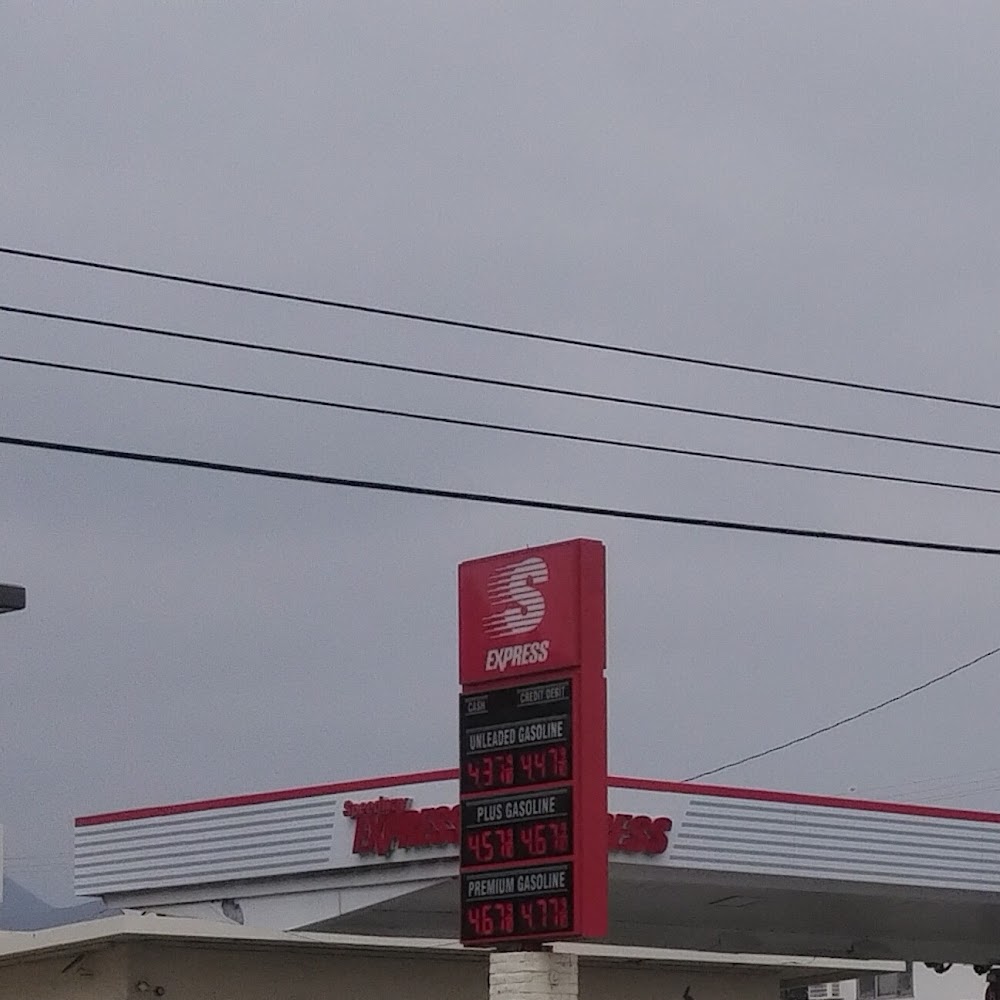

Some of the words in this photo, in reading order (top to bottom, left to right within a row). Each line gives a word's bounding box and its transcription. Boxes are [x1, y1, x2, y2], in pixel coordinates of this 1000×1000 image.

[485, 639, 550, 672] EXPRESS
[467, 700, 486, 713] CASH
[470, 728, 516, 751] UNLEADED
[518, 721, 564, 743] GASOLINE
[477, 803, 503, 824] PLUS
[505, 796, 556, 819] GASOLINE
[468, 877, 515, 898] PREMIUM
[517, 871, 566, 893] GASOLINE
